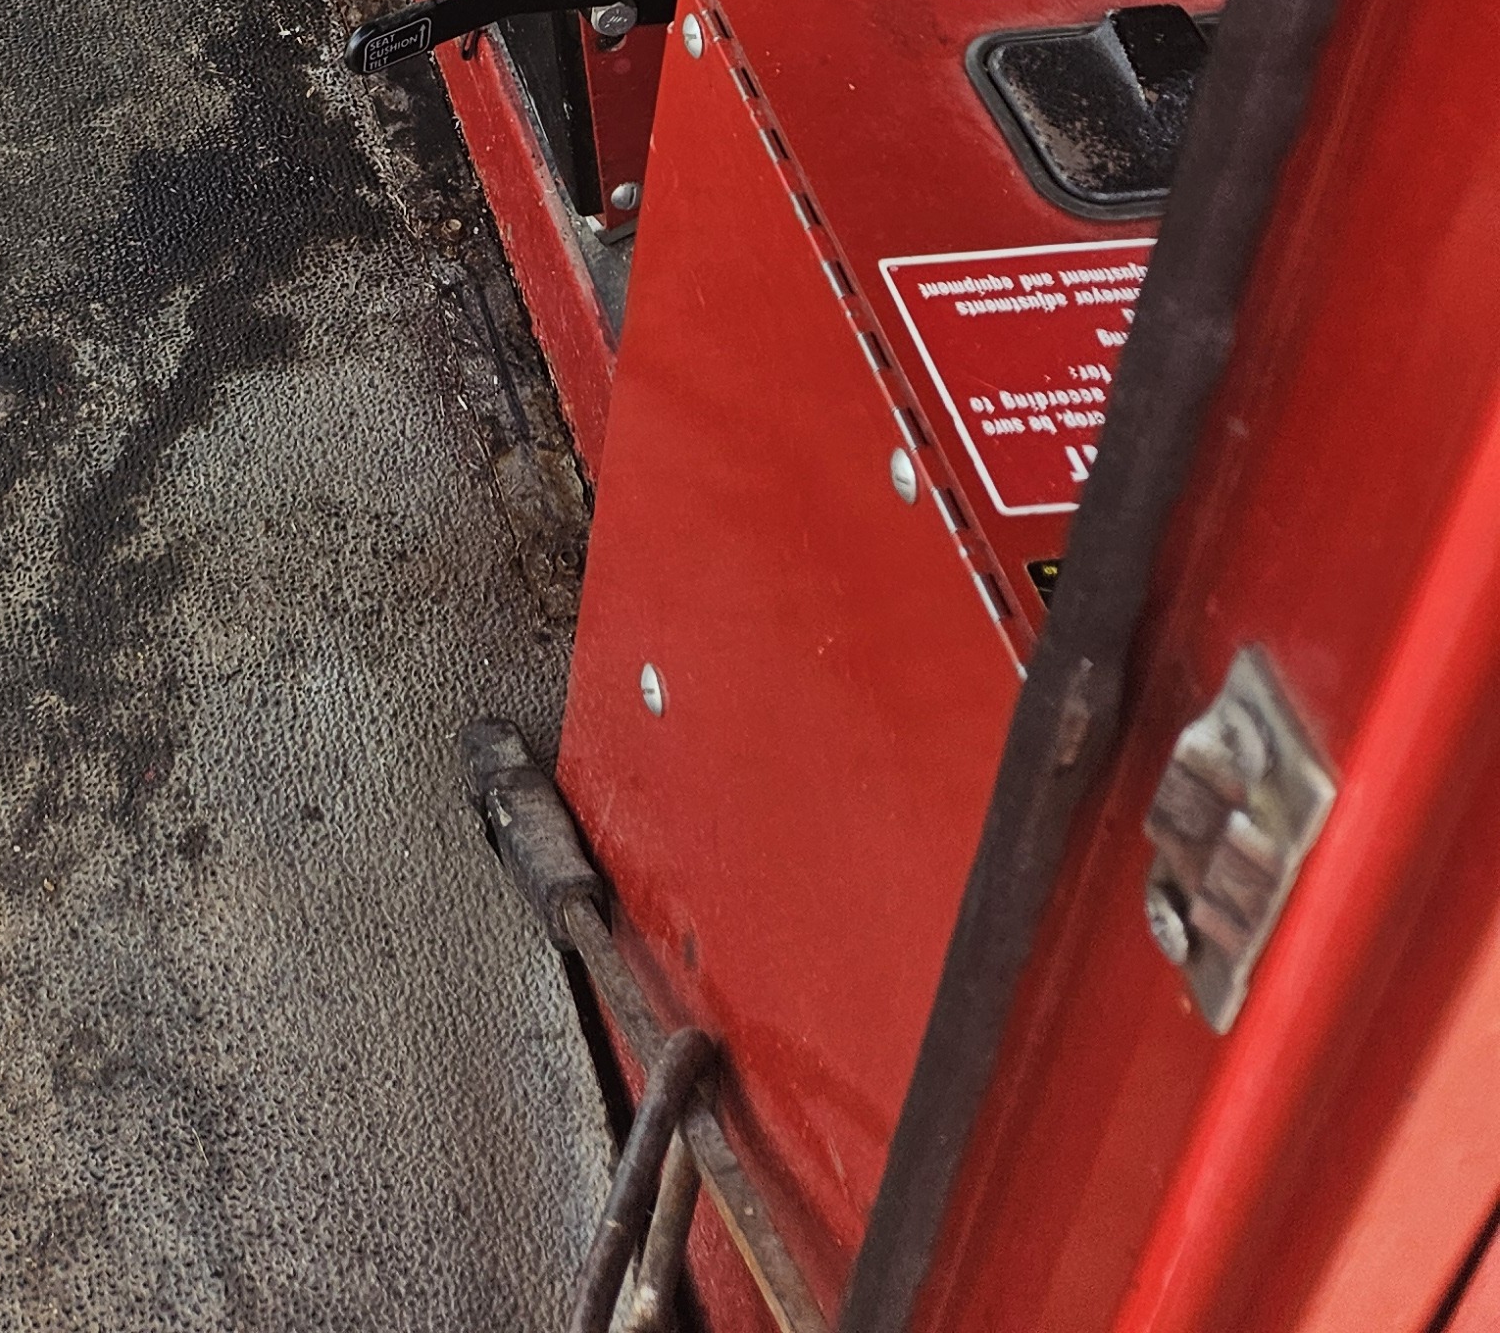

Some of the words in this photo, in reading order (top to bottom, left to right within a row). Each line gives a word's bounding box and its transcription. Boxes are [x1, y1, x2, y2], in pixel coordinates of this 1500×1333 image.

[917, 273, 1015, 300] equipment
[1018, 271, 1056, 293] and
[955, 290, 1069, 317] adjustments
[1068, 363, 1113, 385] for:
[969, 396, 996, 415] to
[1000, 386, 1107, 411] according
[981, 417, 1026, 436] sure
[1028, 414, 1058, 435] be
[1055, 409, 1107, 429] crop,
